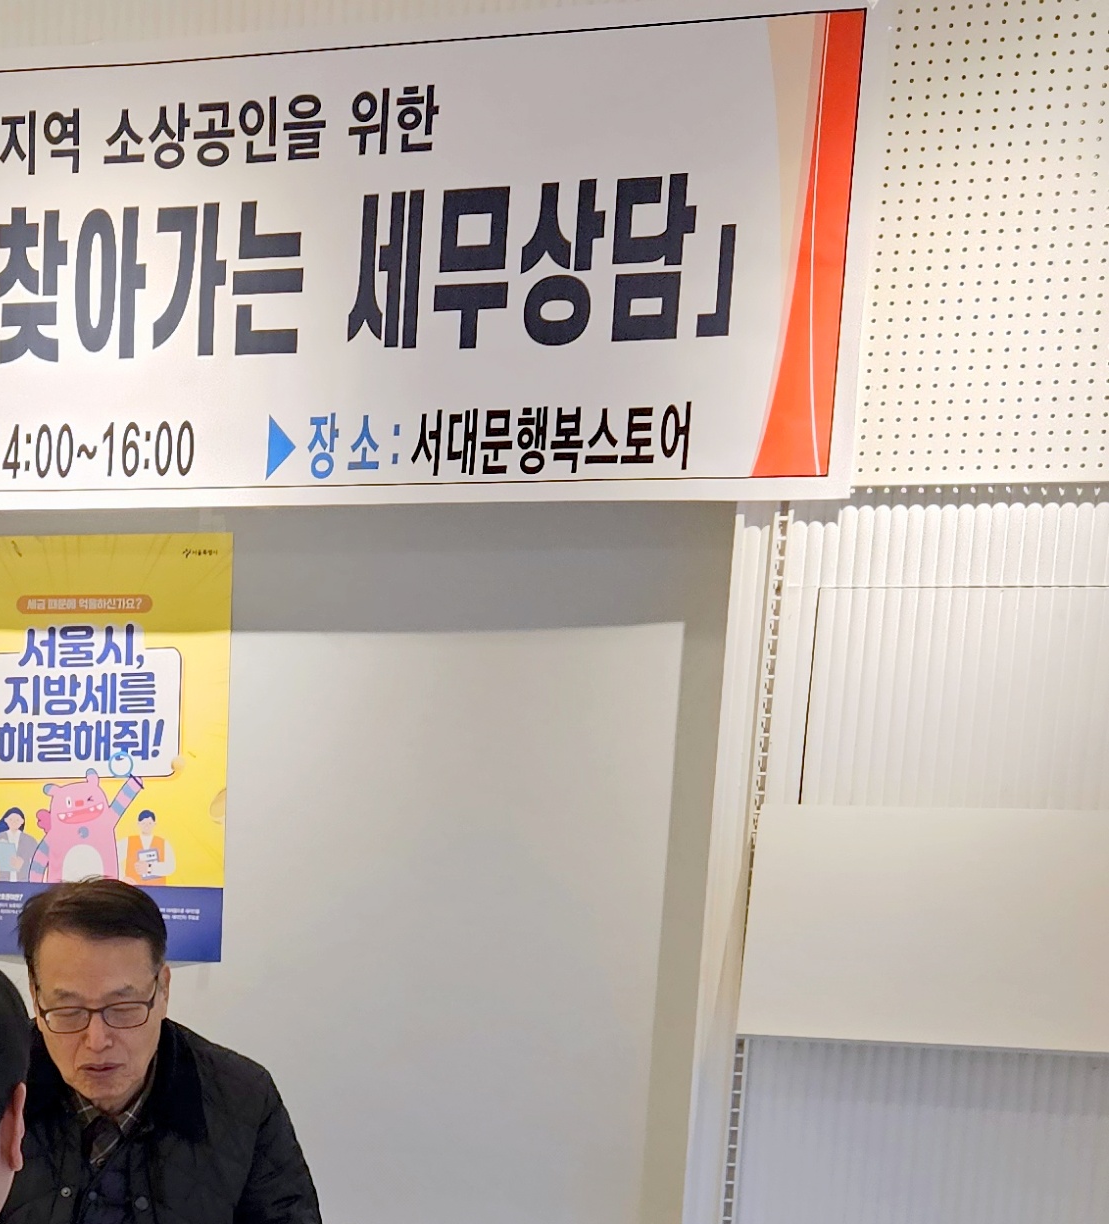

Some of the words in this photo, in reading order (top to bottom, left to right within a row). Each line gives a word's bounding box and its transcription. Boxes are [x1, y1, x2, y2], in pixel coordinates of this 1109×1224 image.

[0, 107, 81, 176] 지역
[102, 94, 327, 170] 소상공인을
[347, 84, 440, 156] 위한
[346, 172, 738, 350] 세무상담」
[410, 400, 692, 477] 서대문행복스토어
[17, 623, 145, 669] 서울시,
[3, 671, 157, 716] 지방세를
